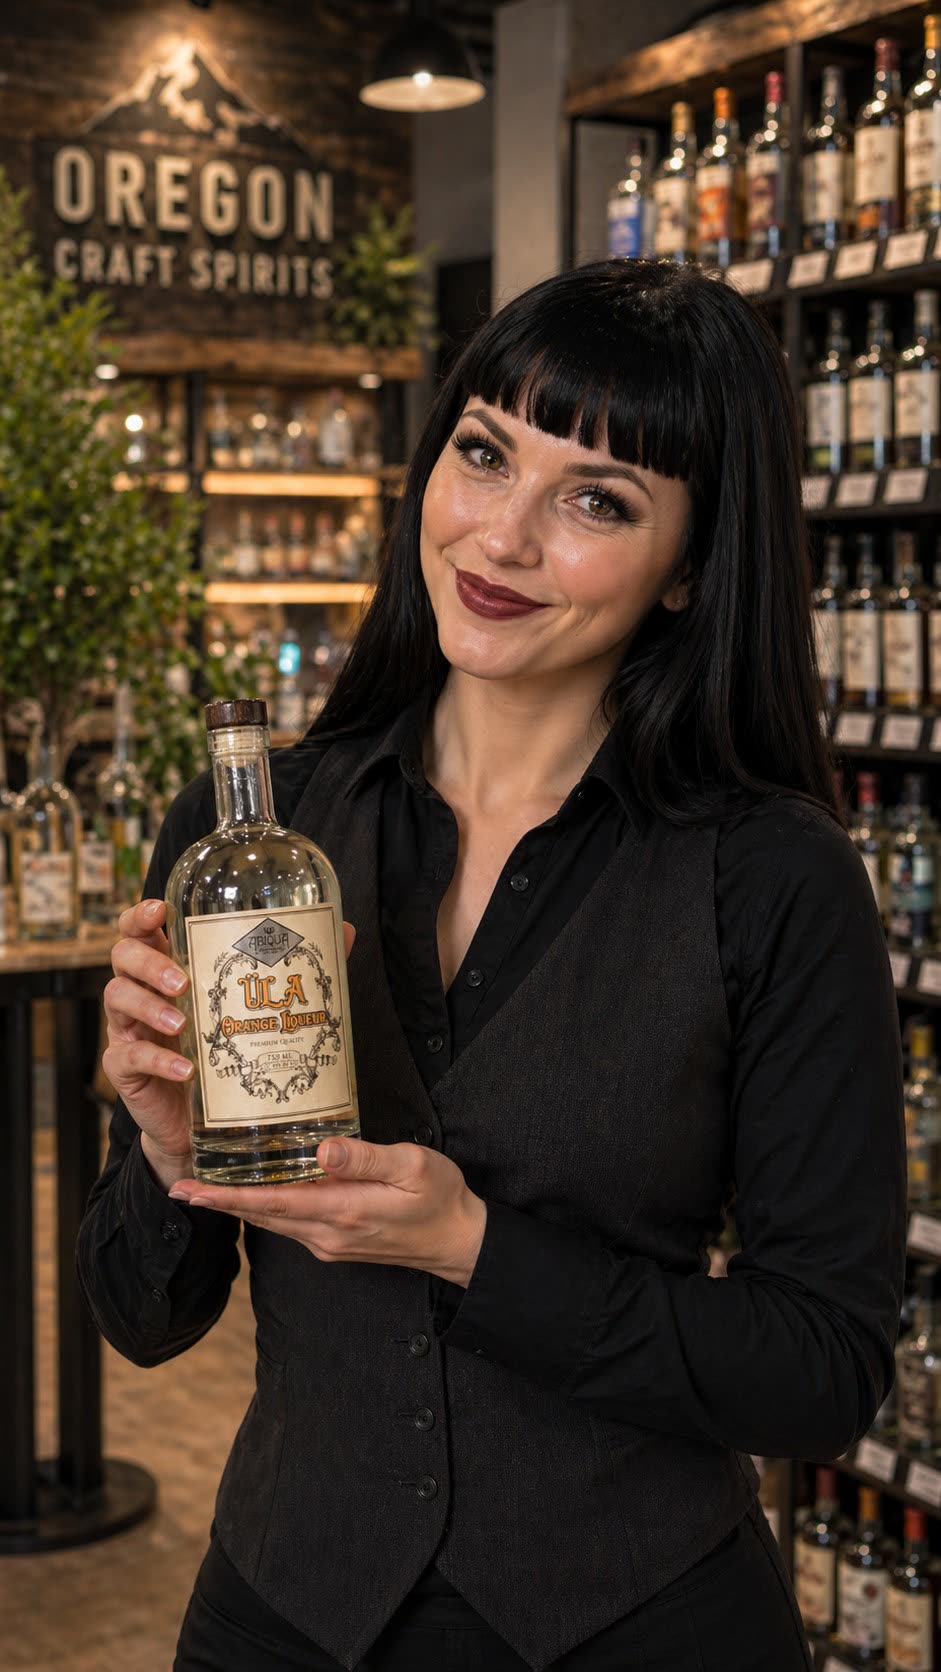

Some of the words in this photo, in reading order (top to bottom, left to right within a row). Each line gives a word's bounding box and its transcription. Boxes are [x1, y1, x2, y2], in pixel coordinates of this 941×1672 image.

[53, 146, 333, 242] OREGON
[53, 238, 176, 288] CRAFT
[190, 249, 333, 298] SPIRITS
[248, 933, 290, 951] ABIQUA
[237, 972, 309, 1010] ÜLA
